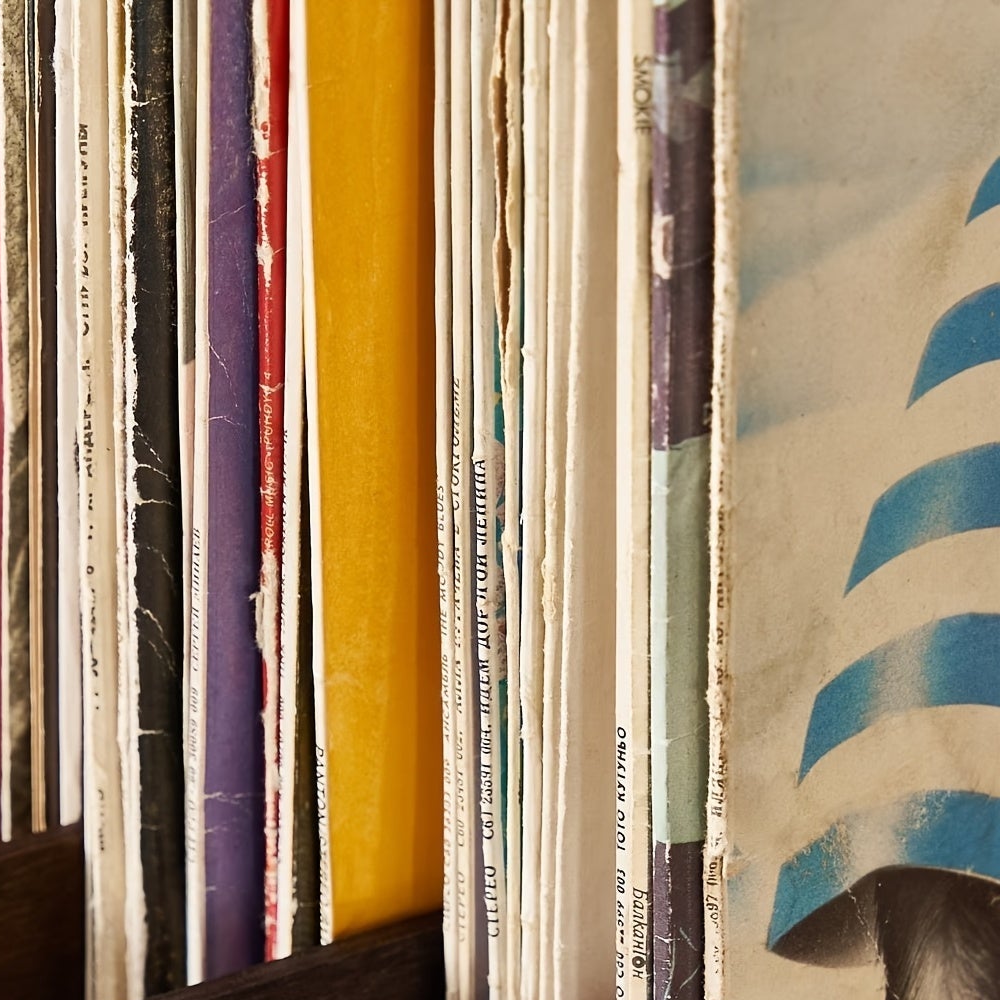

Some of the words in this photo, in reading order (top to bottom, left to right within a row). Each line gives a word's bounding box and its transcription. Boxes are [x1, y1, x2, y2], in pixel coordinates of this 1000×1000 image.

[633, 55, 655, 136] SMOKIE
[616, 726, 627, 803] КУТУНЬО
[616, 809, 626, 851] ТОТО
[484, 865, 500, 938] СТЕРЕО
[616, 868, 626, 894] 003
